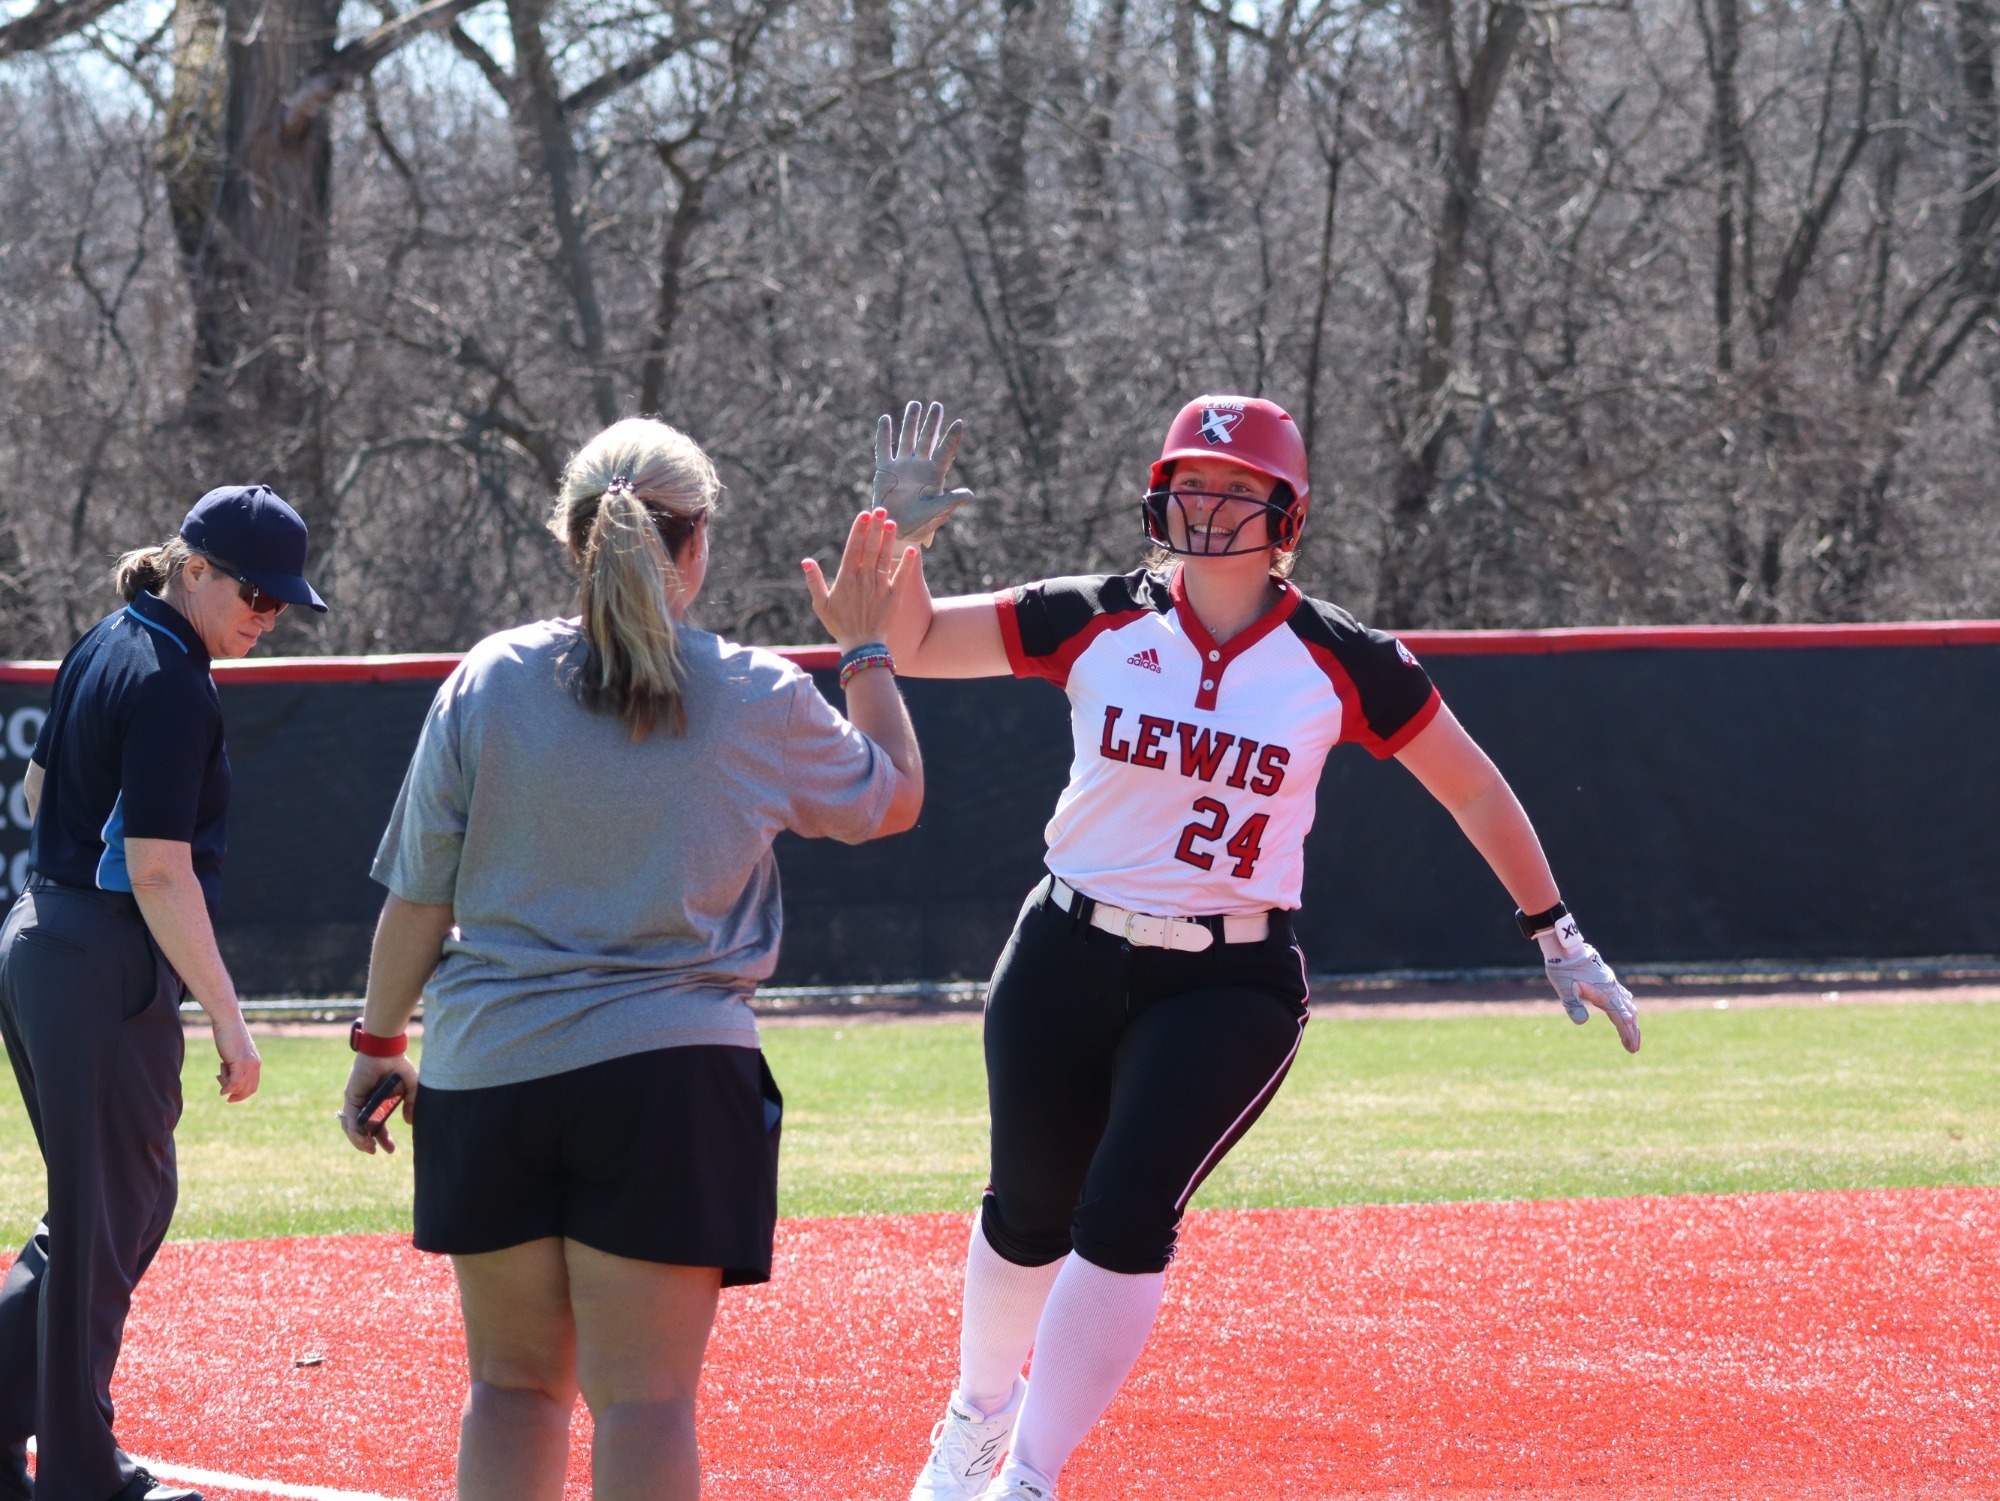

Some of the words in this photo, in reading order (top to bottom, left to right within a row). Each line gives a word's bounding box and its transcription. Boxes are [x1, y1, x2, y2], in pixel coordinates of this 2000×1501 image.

[1205, 402, 1245, 411] LEWIS
[1127, 656, 1161, 673] adidas
[1100, 705, 1290, 797] LEWIS
[1174, 796, 1271, 879] 24
